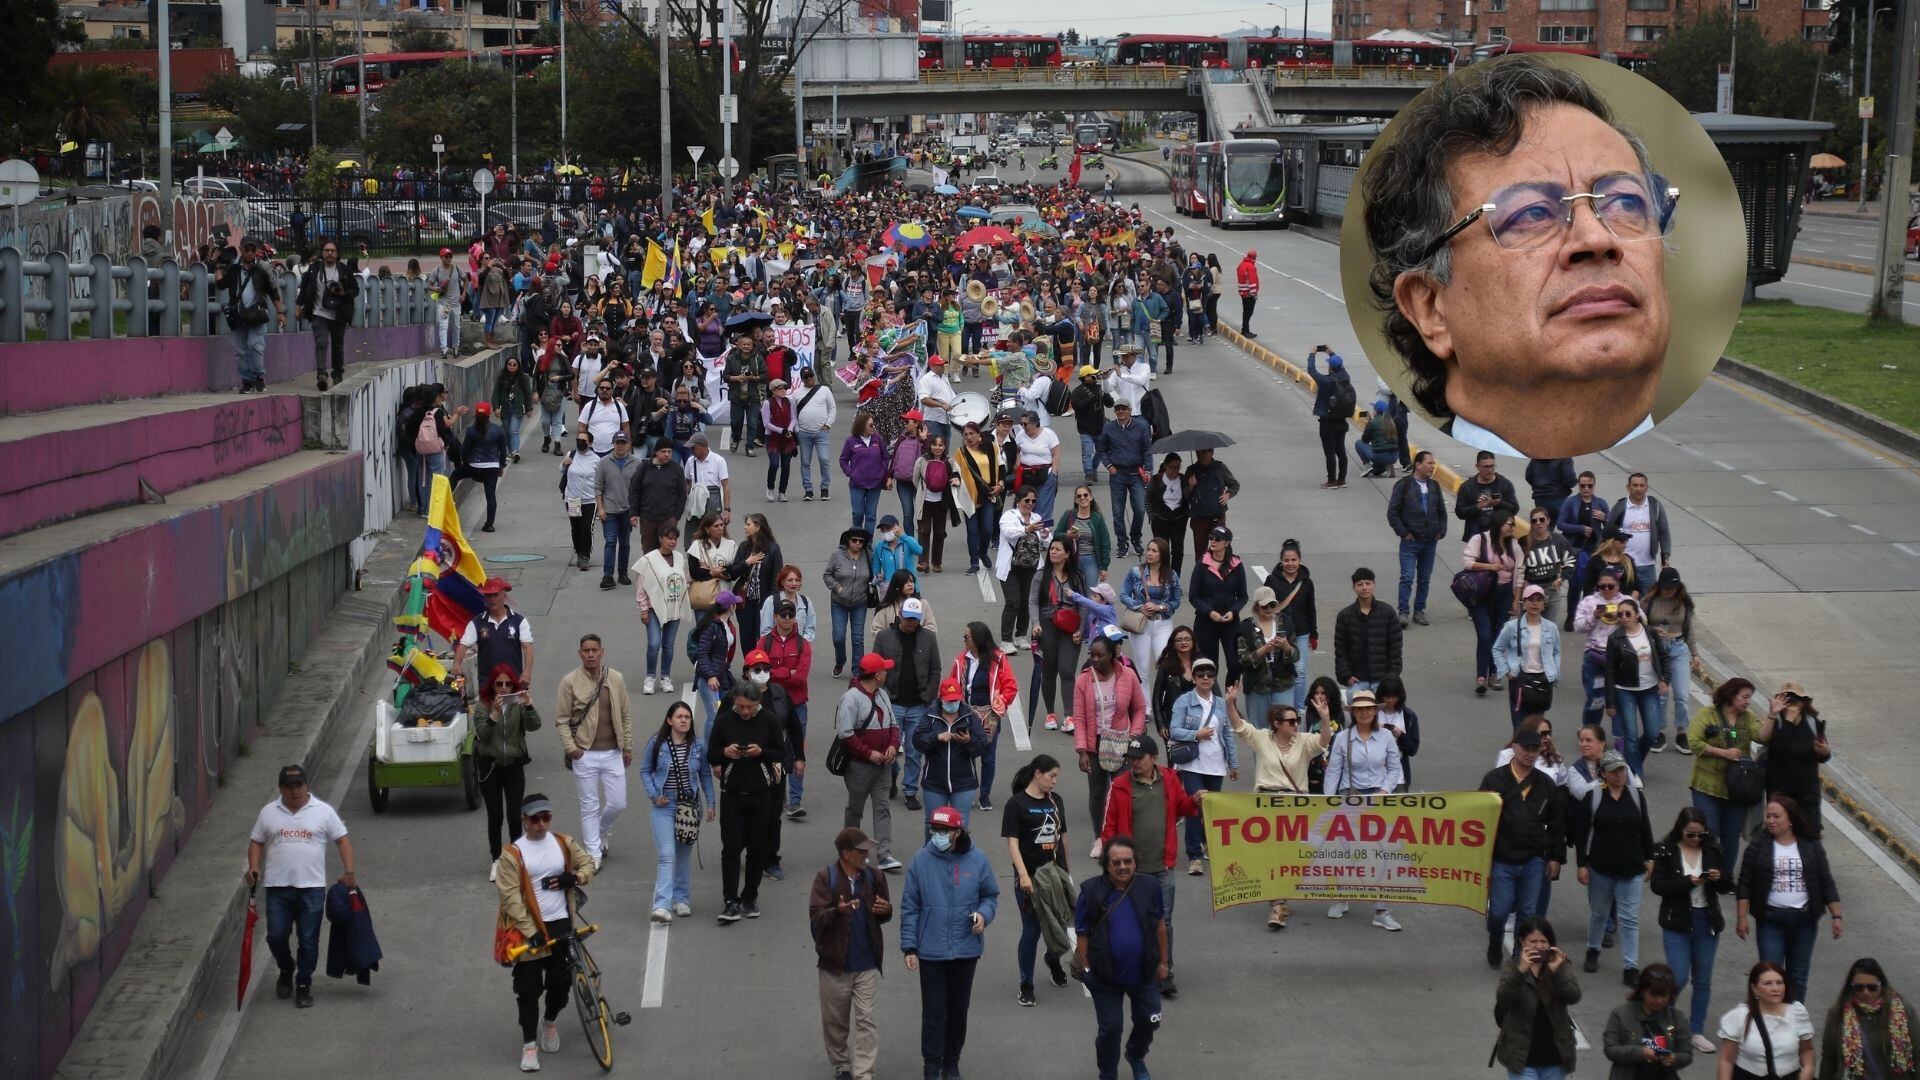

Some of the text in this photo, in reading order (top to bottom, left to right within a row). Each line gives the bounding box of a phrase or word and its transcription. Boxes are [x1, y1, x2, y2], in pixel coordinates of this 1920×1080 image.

[760, 40, 783, 48] LLER
[1256, 795, 1447, 810] I.E.D. COLEGIO
[280, 828, 313, 840] fecode
[1212, 814, 1487, 848] TOM ADAMS
[1299, 849, 1351, 860] Localidad
[1354, 849, 1368, 860] 08
[1280, 865, 1366, 878] PRESENTE
[1397, 866, 1482, 886] PRESENTE
[1215, 890, 1262, 907] Educación
